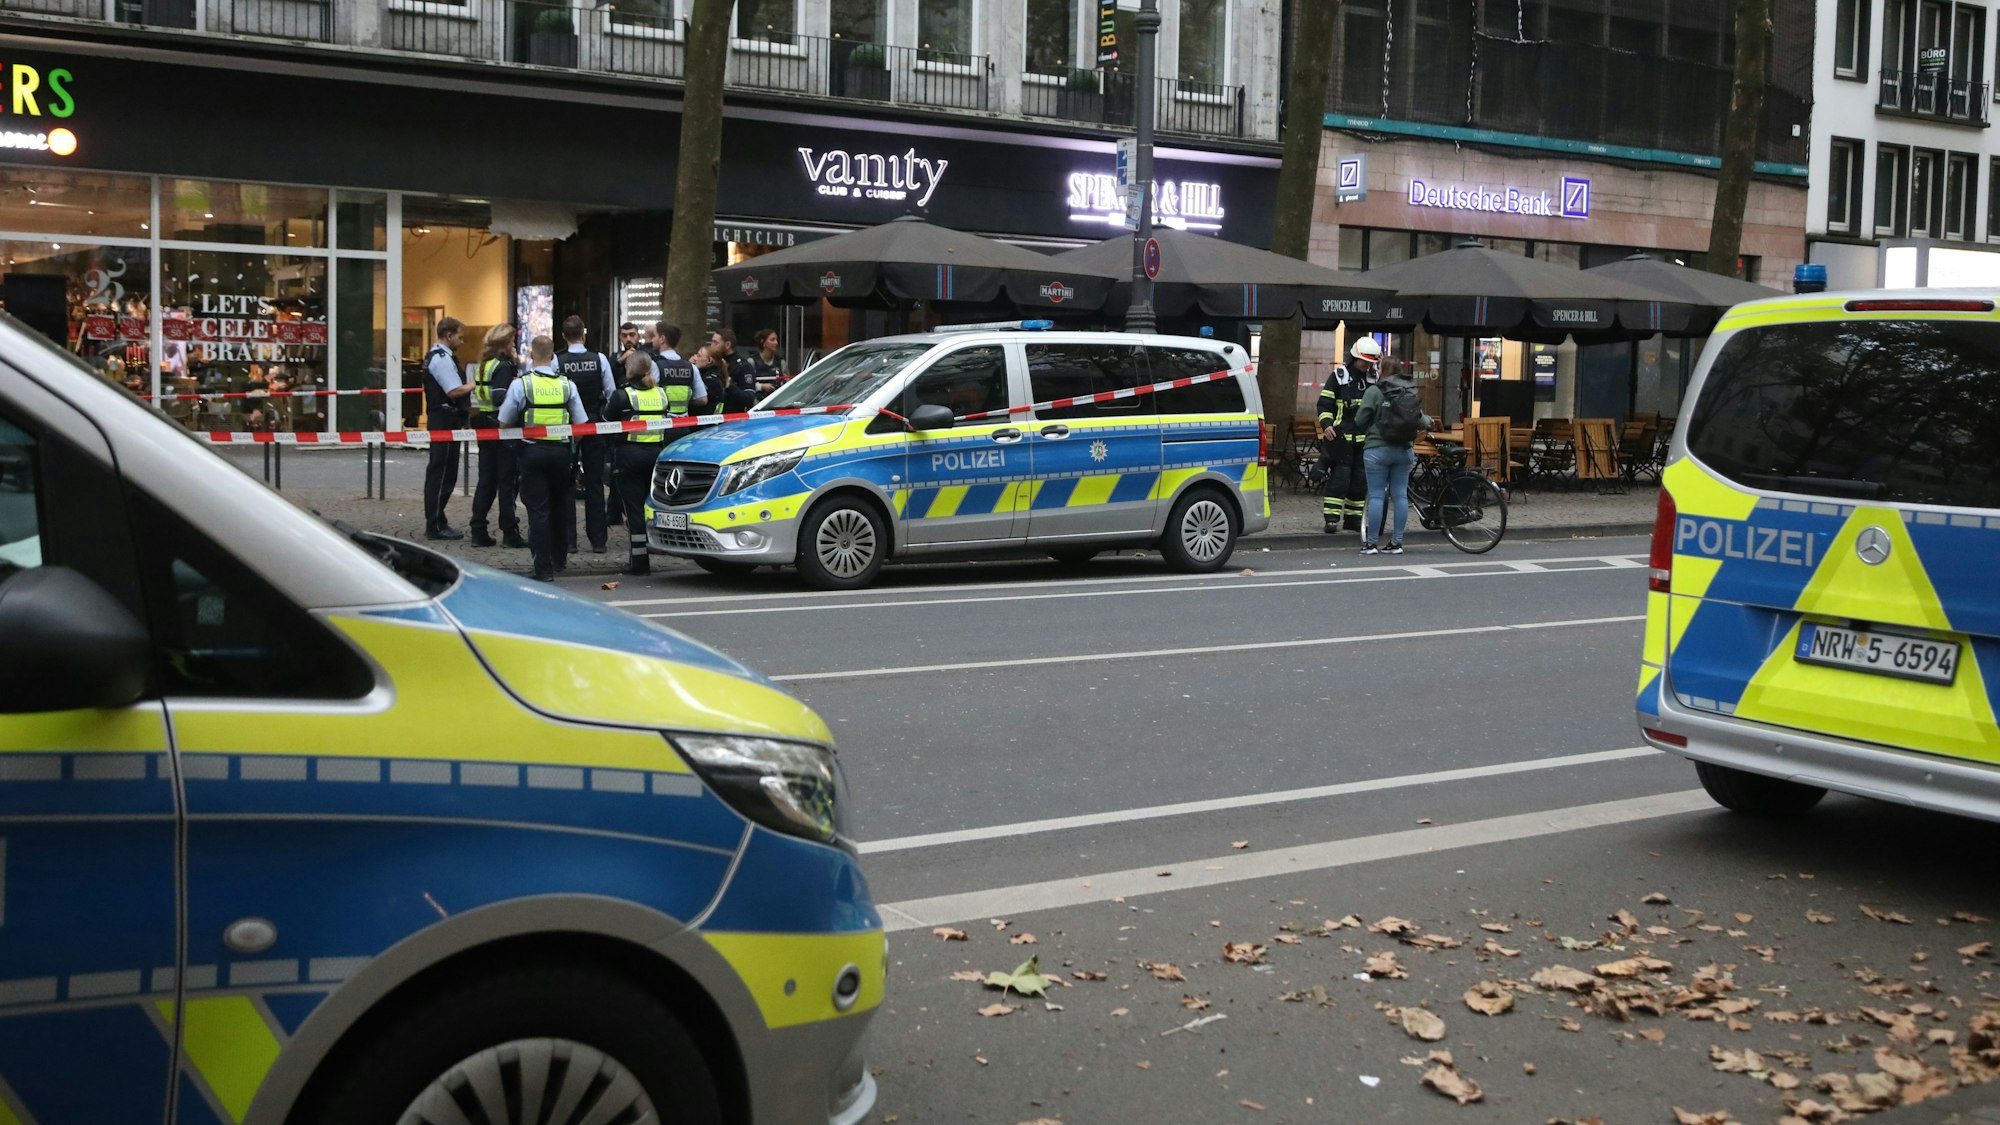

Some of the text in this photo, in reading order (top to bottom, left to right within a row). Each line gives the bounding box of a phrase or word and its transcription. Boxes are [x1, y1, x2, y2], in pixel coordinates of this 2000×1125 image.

[1920, 48, 1946, 59] BÜRO
[0, 63, 75, 118] RS
[798, 147, 949, 207] vanity
[818, 184, 848, 197] CLUB
[852, 187, 862, 198] &
[1068, 172, 1225, 218] SPENR & HILL
[1408, 179, 1553, 216] Deutsche Bank
[714, 228, 795, 247] IGHTCLUB
[820, 277, 841, 287] MARTINI
[1040, 285, 1073, 298] MARTINI
[201, 294, 276, 315] LET'S
[1322, 299, 1372, 313] SPENCER & HILL
[1391, 307, 1404, 319] HILL
[1553, 309, 1598, 322] SPENCER & HILL
[201, 318, 269, 339] CELE
[564, 361, 597, 373] POLIZEI
[664, 367, 691, 379] POLIZEI
[931, 449, 1006, 472] POLIZEI
[1677, 517, 1815, 568] POLIZEI
[1811, 628, 1858, 661] NRW
[1866, 637, 1952, 675] 5-6594
